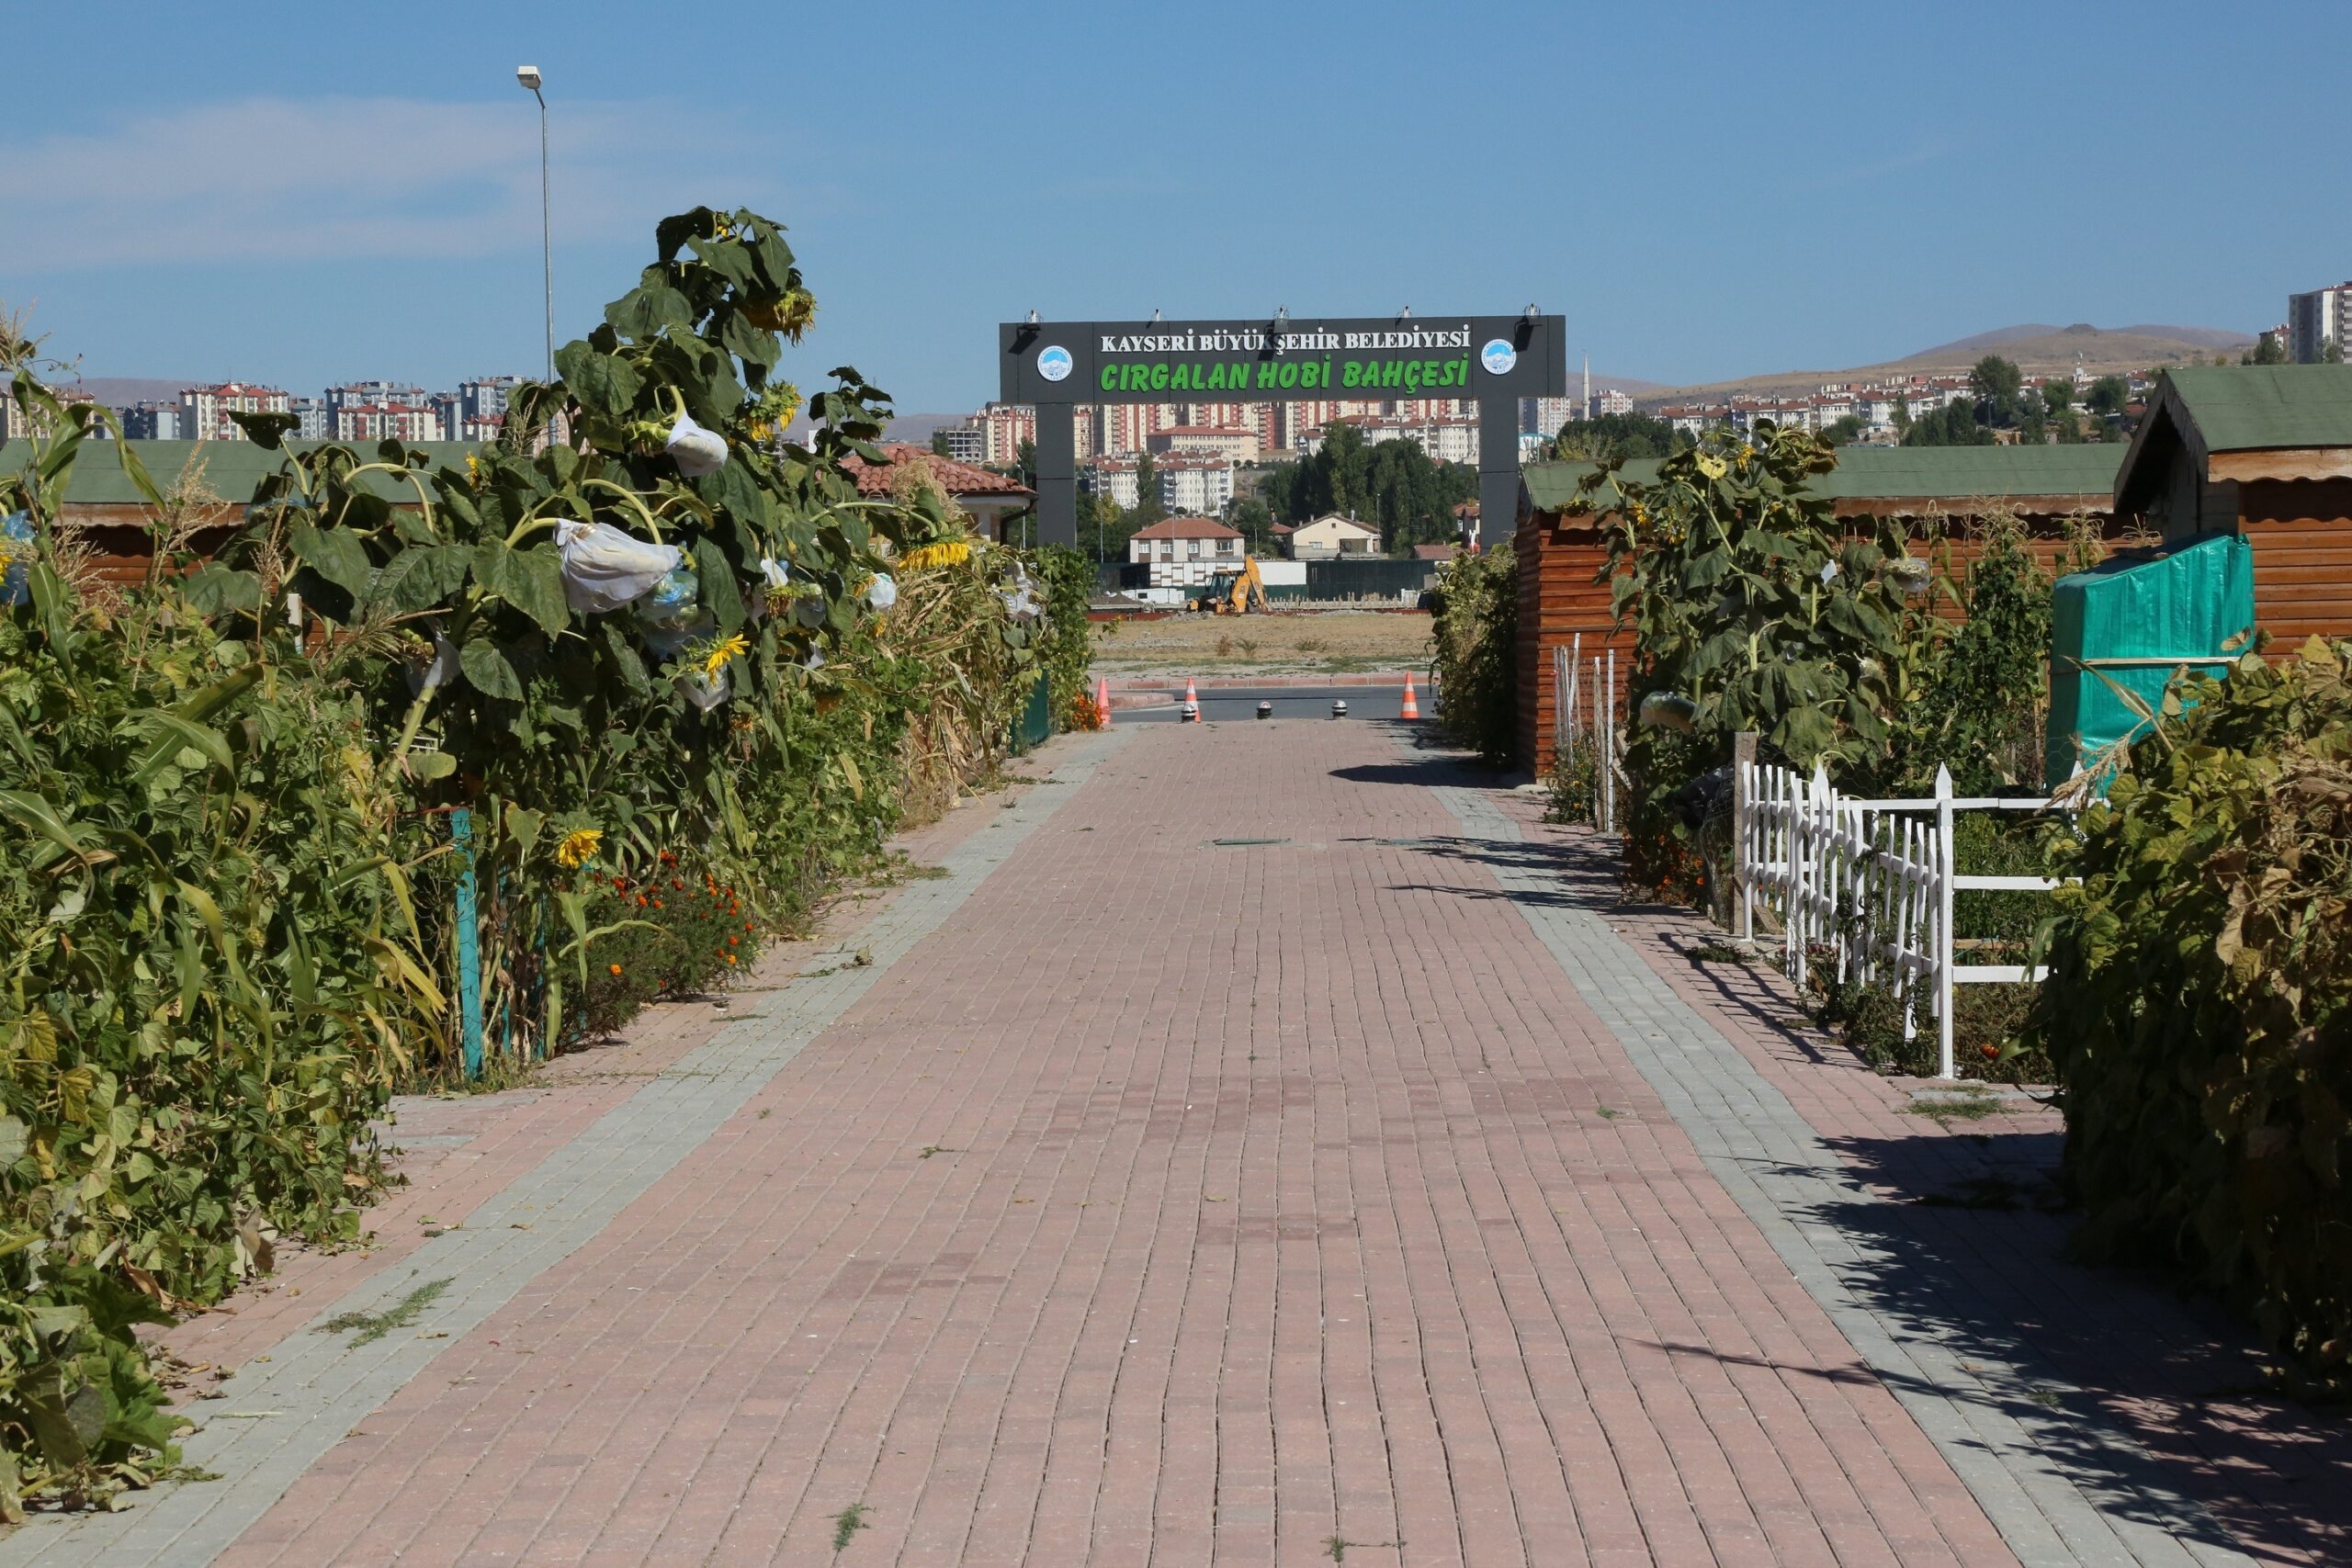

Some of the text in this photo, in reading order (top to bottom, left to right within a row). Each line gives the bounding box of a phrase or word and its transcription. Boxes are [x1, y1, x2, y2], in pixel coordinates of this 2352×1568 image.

[1101, 324, 1471, 355] KAYSERİ BÜYÜKŞEHİR BELEDİYESİ
[1101, 363, 1250, 392] CIRGALAN
[1257, 354, 1331, 389] HOBİ
[1342, 353, 1469, 393] BAHÇESİ
